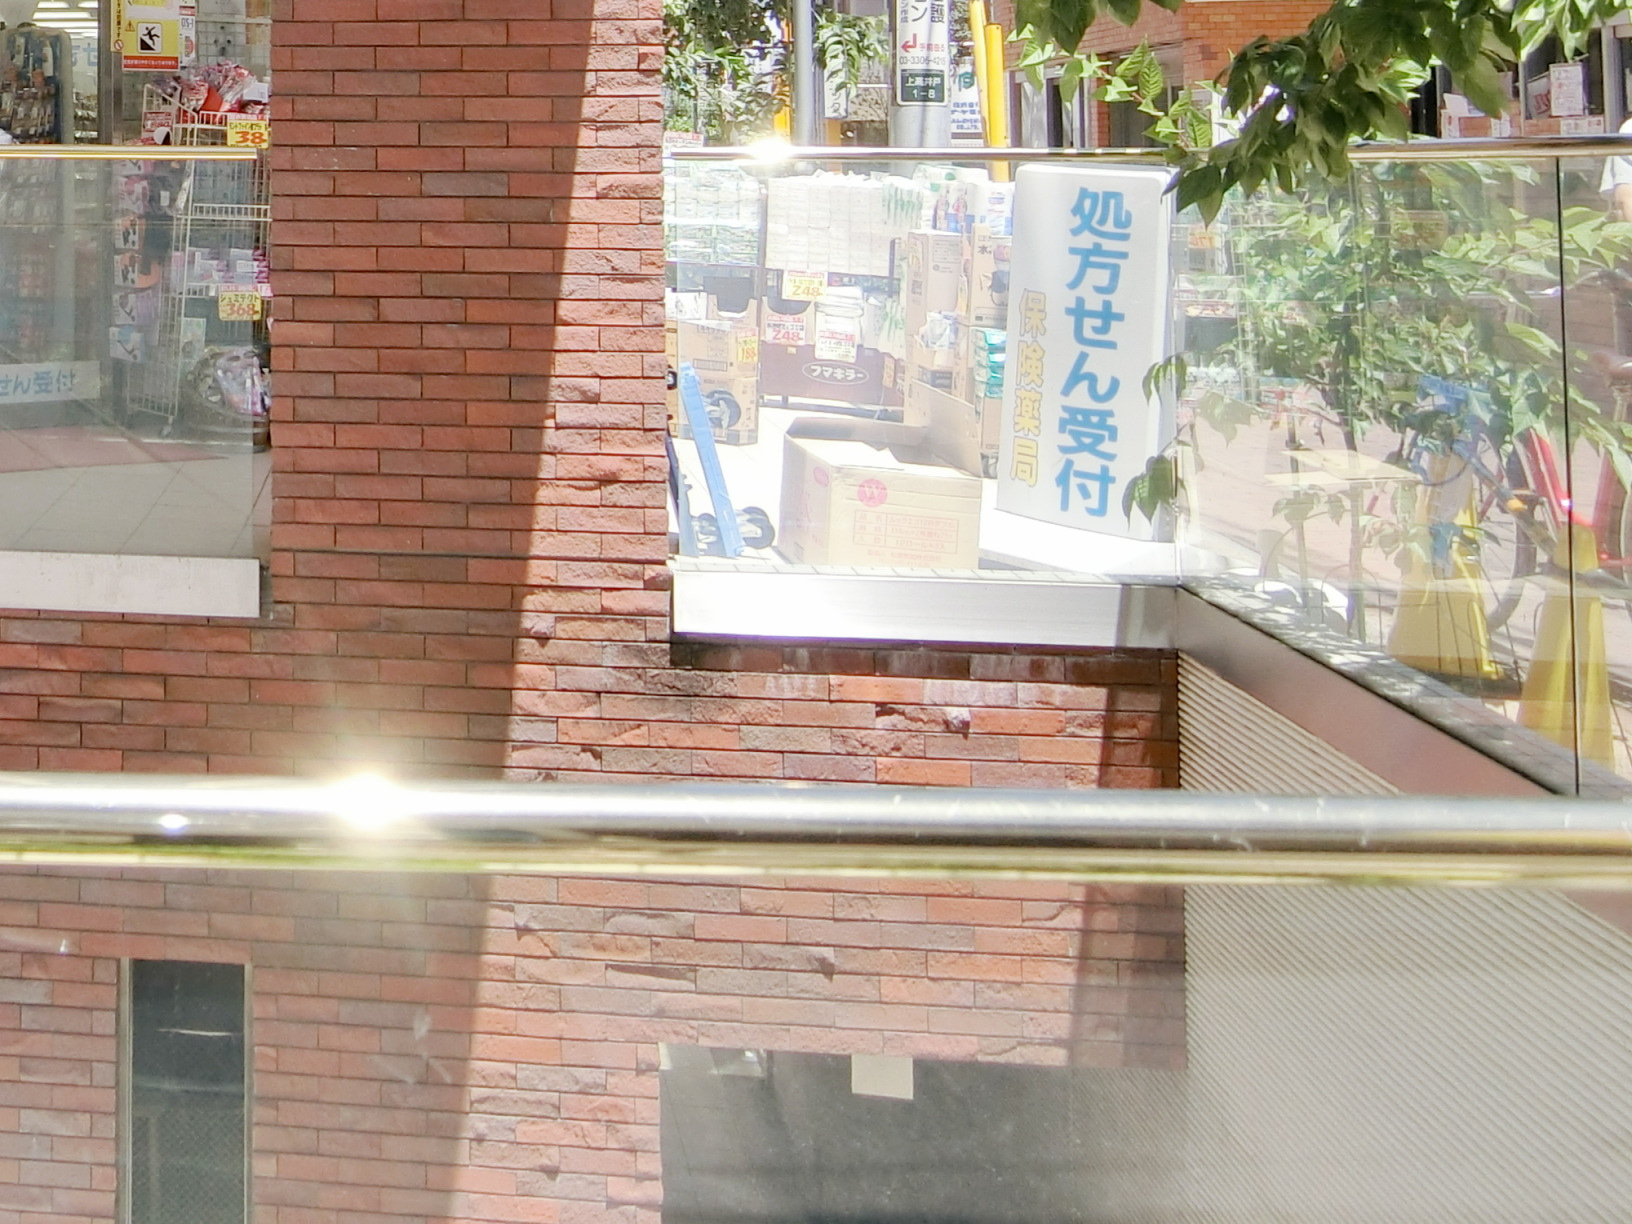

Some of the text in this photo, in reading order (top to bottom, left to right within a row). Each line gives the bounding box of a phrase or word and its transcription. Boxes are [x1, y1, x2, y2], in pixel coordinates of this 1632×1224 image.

[905, 77, 941, 86] 上高井戸
[810, 365, 864, 380] フマキラー
[1010, 289, 1047, 487] 保険薬局
[1055, 187, 1133, 518] 処方せん受付
